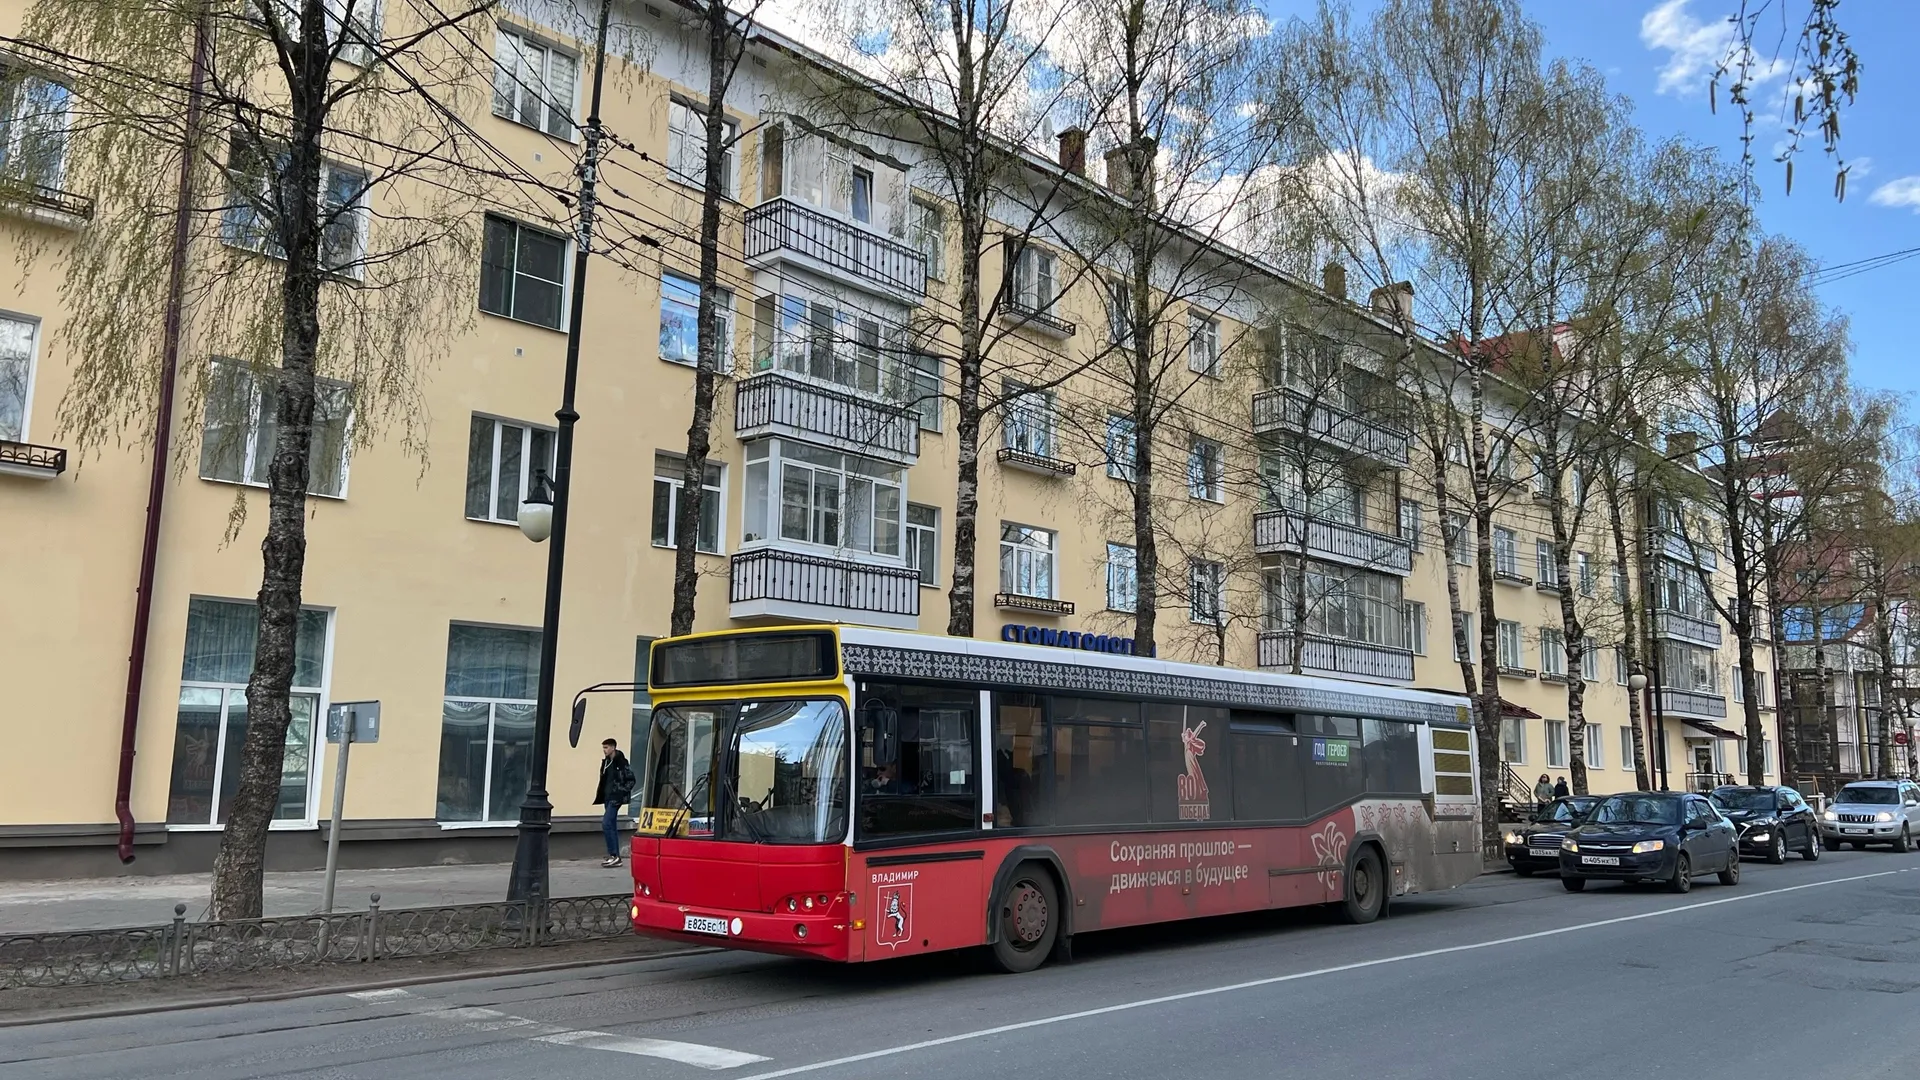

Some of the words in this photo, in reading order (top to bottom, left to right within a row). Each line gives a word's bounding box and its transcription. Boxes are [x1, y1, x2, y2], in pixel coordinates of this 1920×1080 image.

[1002, 623, 1156, 658] СТОМАТОЛОГ
[1314, 742, 1325, 757] ГОД
[1327, 743, 1348, 757] ГЕРОЕВ
[1179, 774, 1197, 801] 80
[641, 811, 654, 829] 24
[1179, 804, 1210, 821] ПОБЕДА!
[1110, 840, 1176, 866] Сохраняя
[1180, 840, 1235, 862] прошлое
[872, 870, 919, 883] ВЛАДИМИР
[1110, 869, 1181, 894] движемся
[1185, 868, 1192, 884] в
[1196, 863, 1249, 887] будущее
